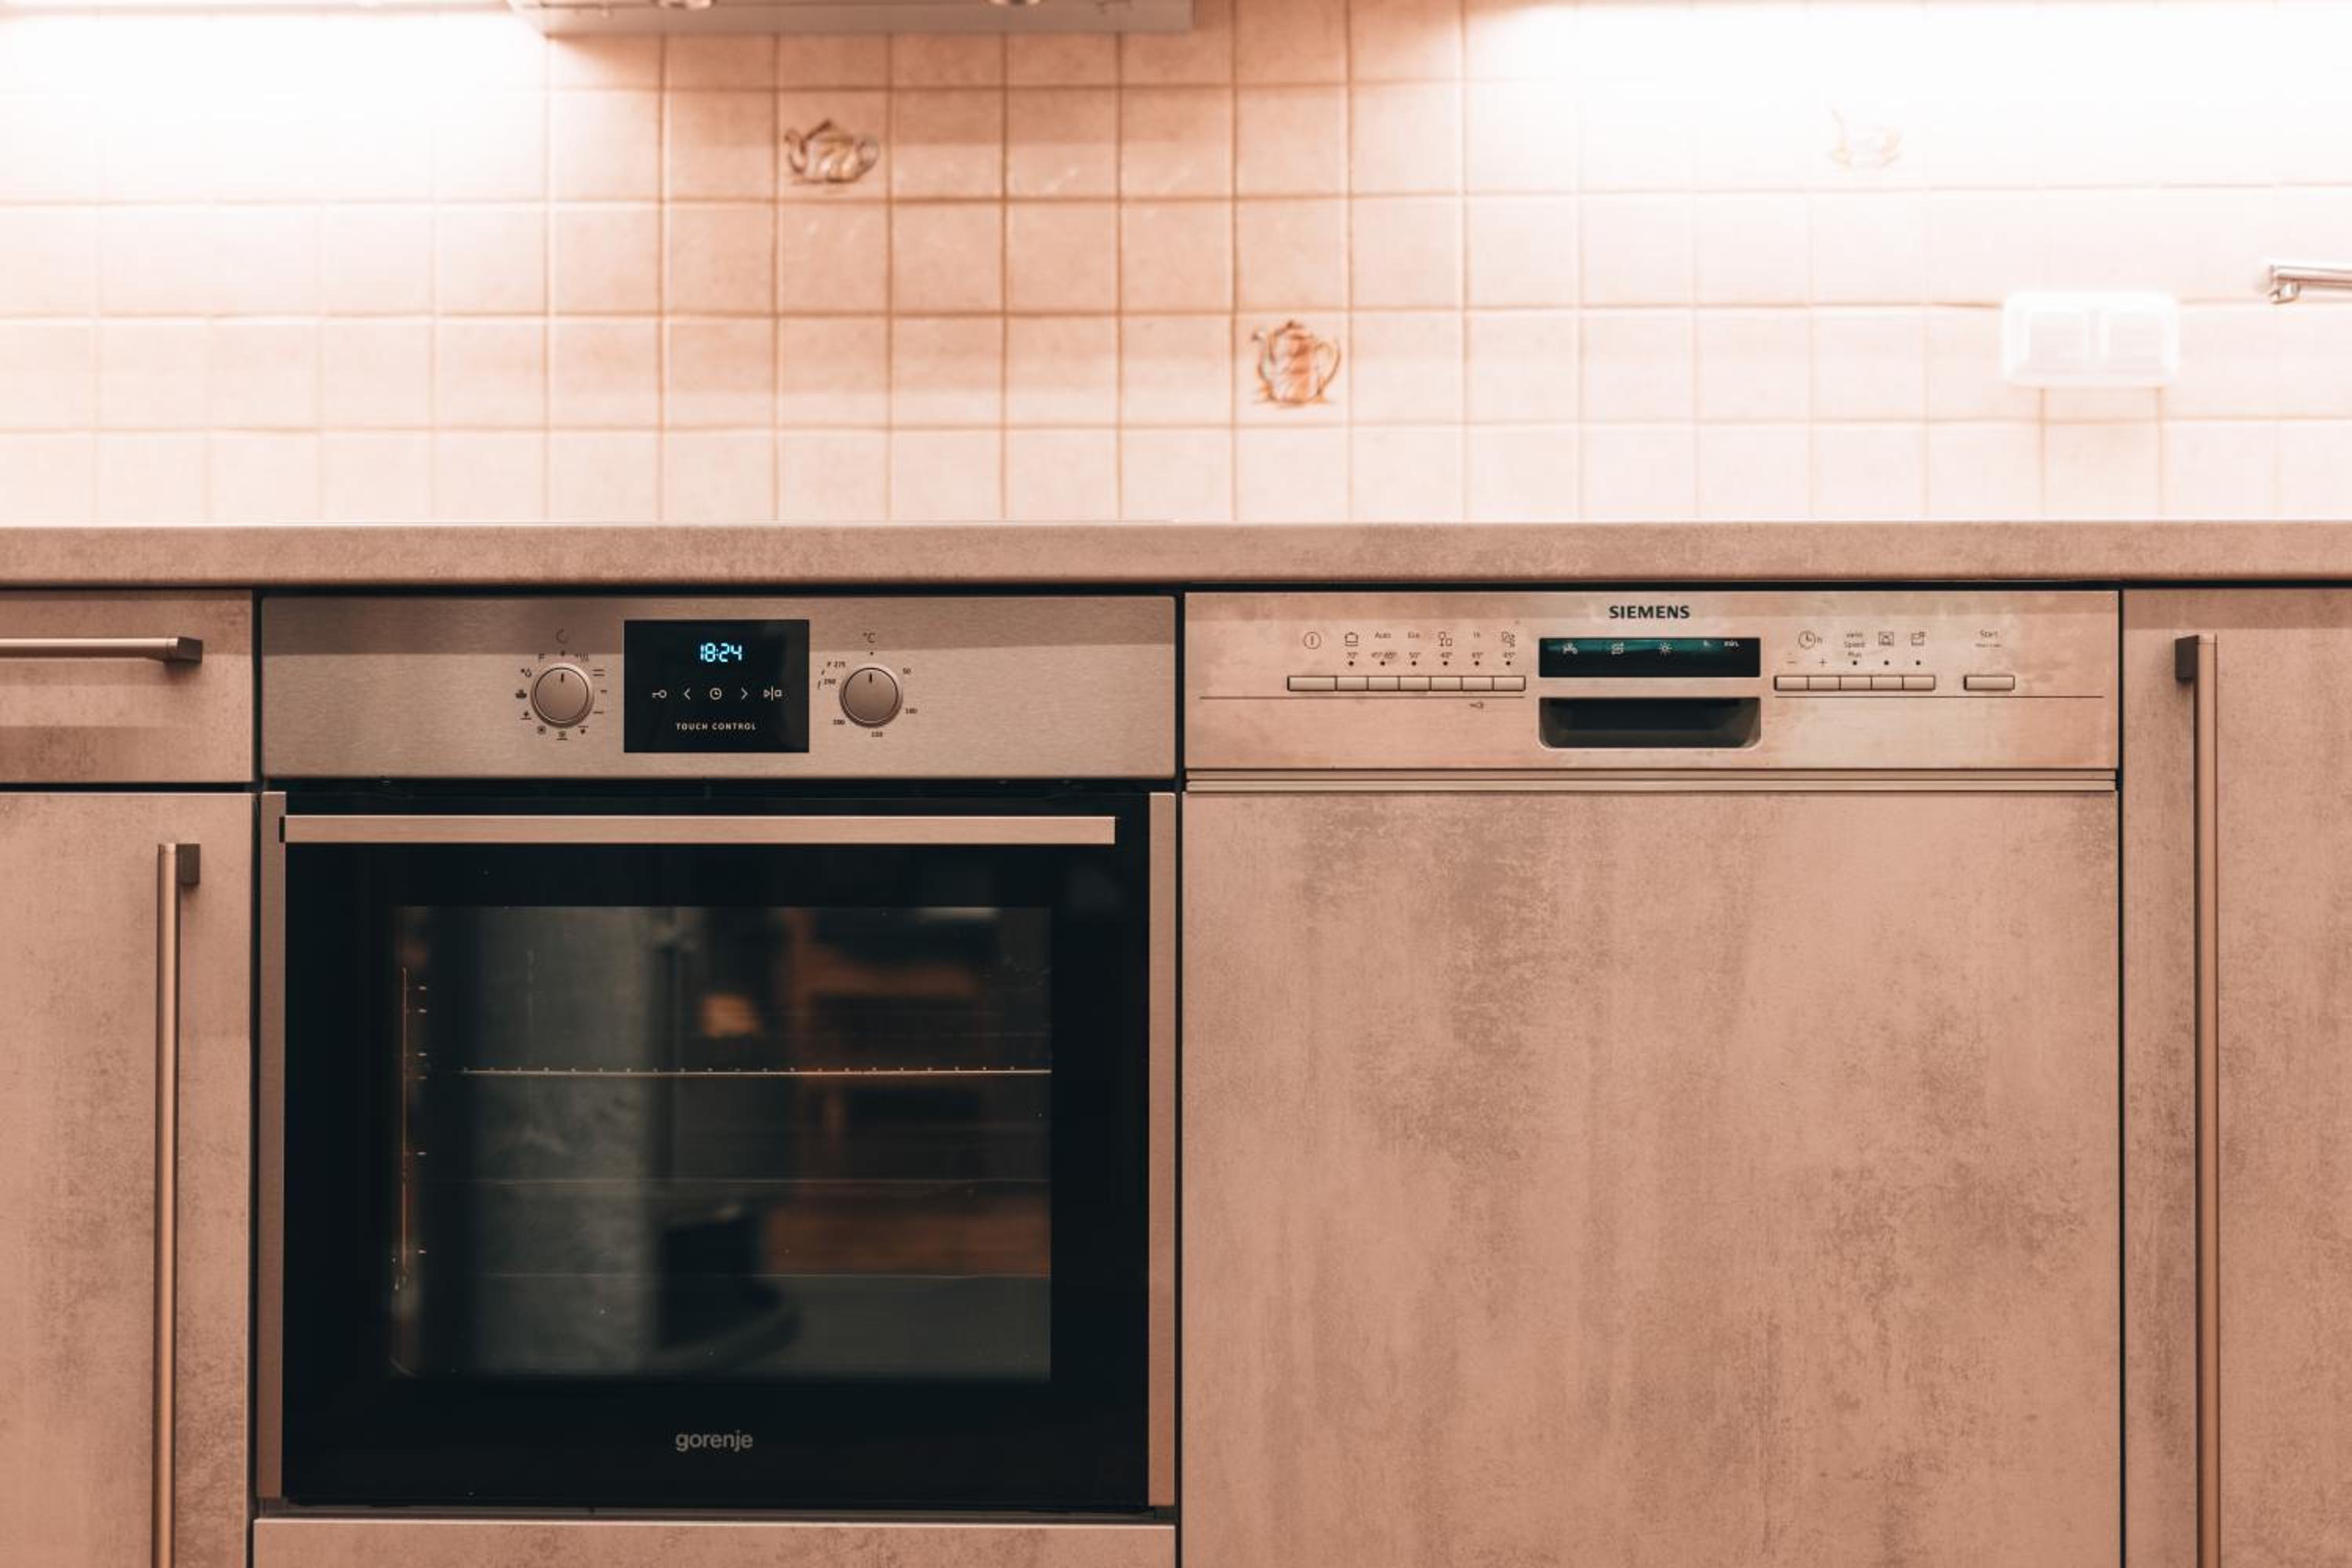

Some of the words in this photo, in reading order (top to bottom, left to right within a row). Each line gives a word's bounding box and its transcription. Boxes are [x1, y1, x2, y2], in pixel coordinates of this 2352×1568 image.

[1609, 605, 1690, 619] SIEMENS
[700, 642, 743, 662] 18:24
[677, 722, 708, 731] TOUCH
[711, 722, 757, 731] CONTROL
[675, 1429, 753, 1452] gorenje
